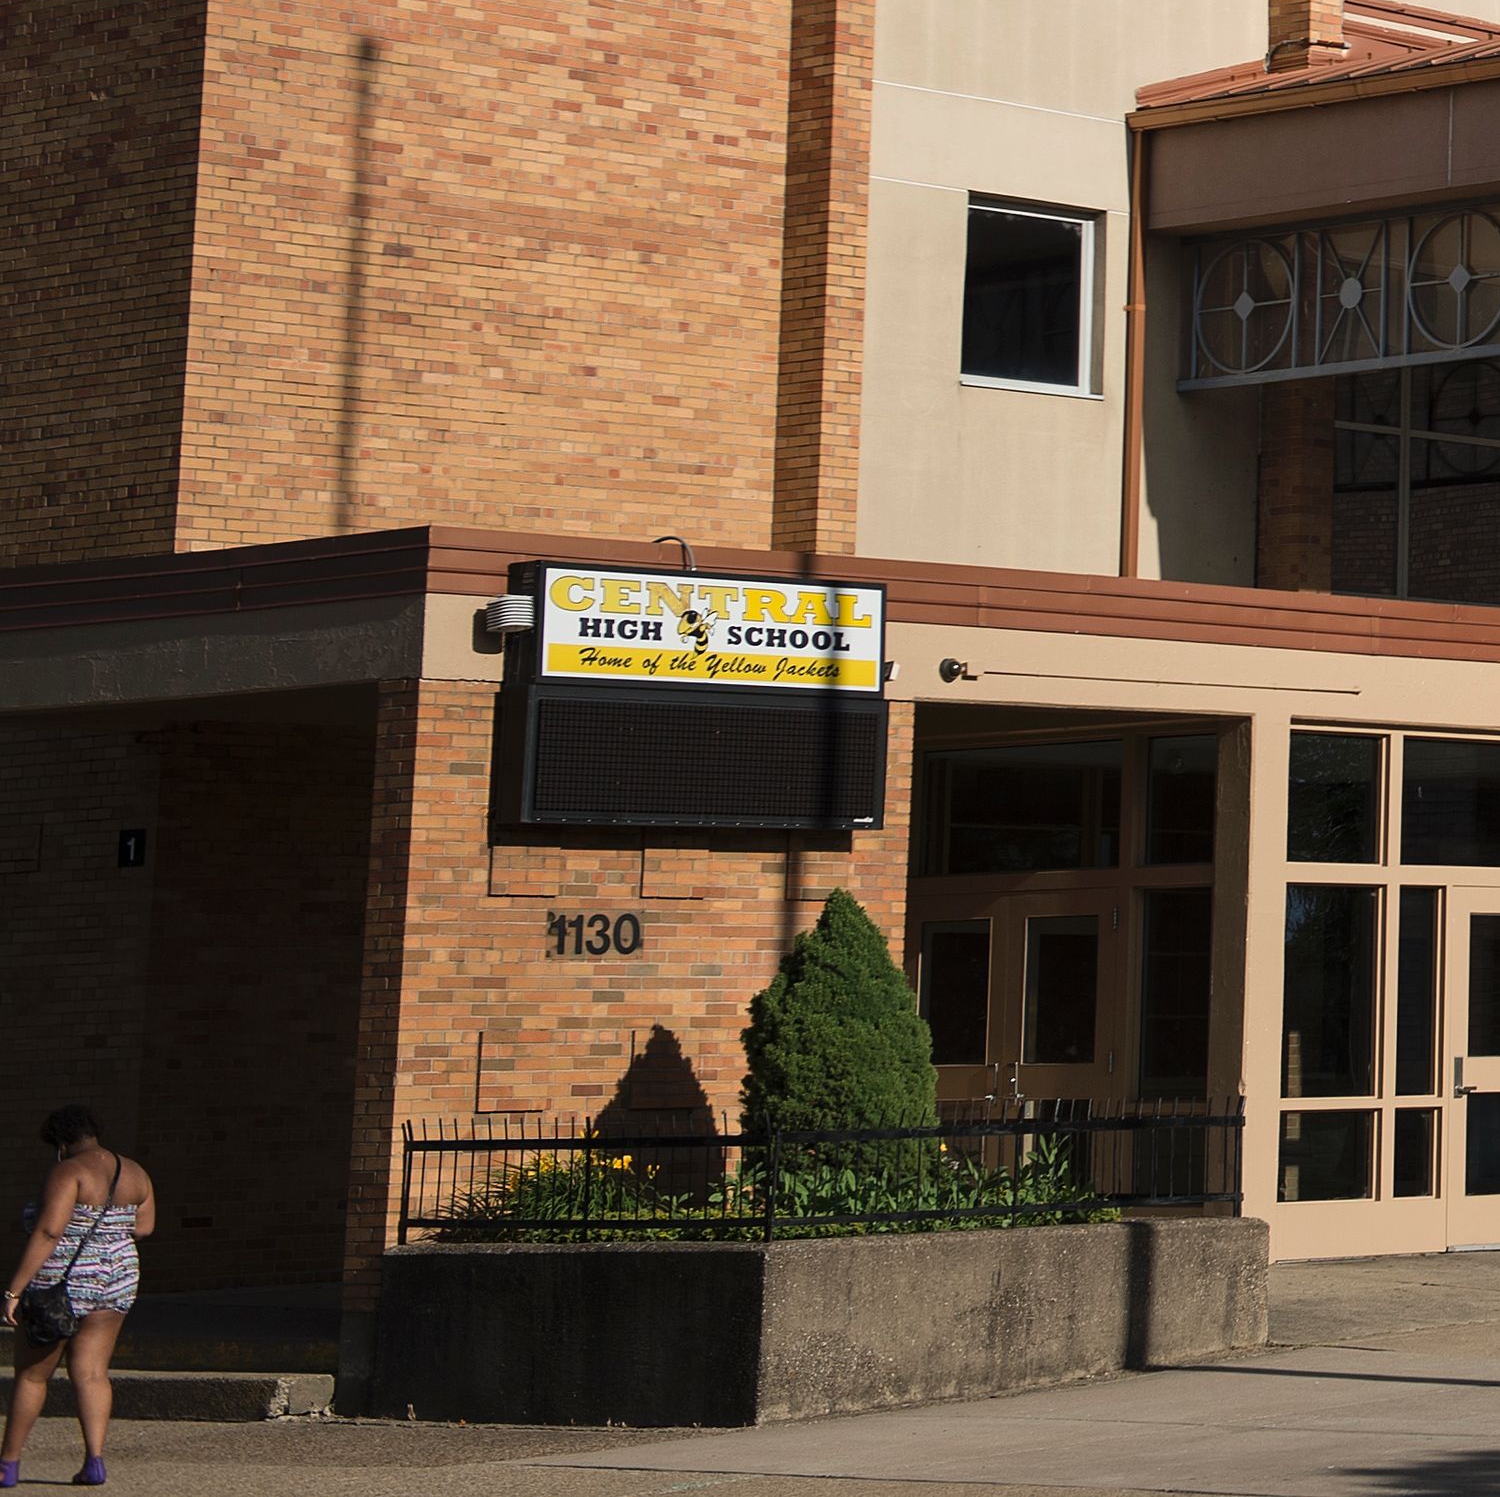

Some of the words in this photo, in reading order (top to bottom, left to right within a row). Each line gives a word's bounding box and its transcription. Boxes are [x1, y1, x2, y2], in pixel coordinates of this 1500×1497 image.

[549, 575, 873, 629] CENTRAL
[578, 617, 663, 641] HIGH
[727, 625, 850, 652] SCHOOL
[578, 647, 631, 669] Home
[641, 654, 660, 673] of
[669, 654, 697, 671] the
[705, 657, 766, 677] Yellow
[773, 658, 841, 680] Jackets
[126, 837, 136, 861] 1
[550, 913, 641, 955] 1130
